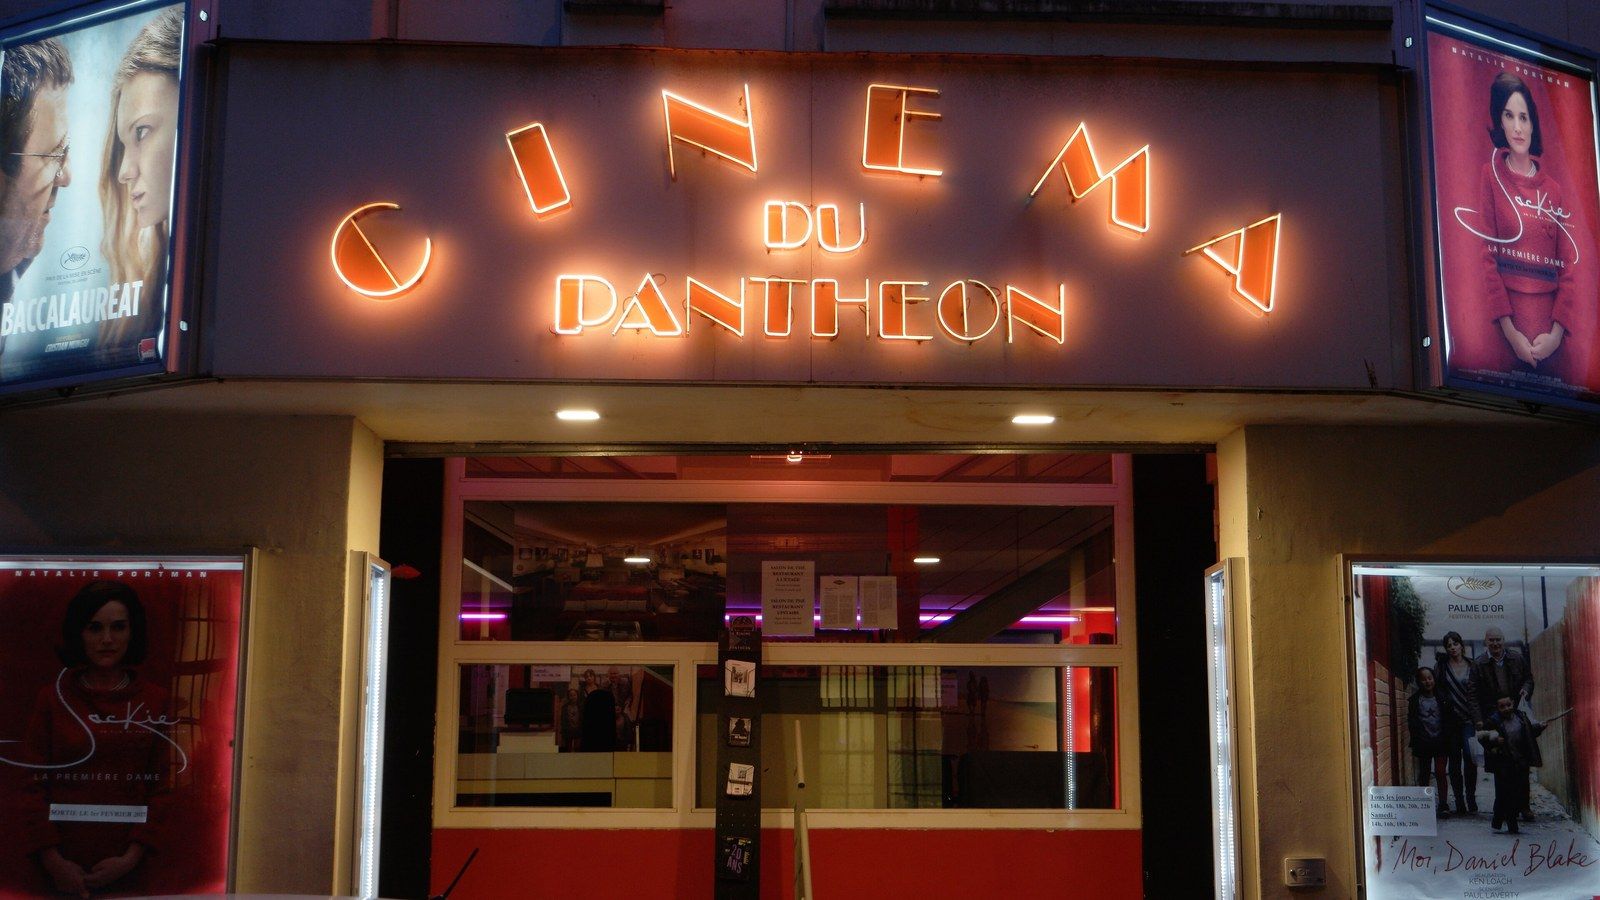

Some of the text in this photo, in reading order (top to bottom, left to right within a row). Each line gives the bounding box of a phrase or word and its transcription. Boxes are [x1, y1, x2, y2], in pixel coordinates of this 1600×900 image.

[1451, 46, 1570, 88] NATALIE PORTMAN
[331, 83, 1282, 312] CINEMA
[1453, 147, 1579, 265] Jackie
[763, 199, 865, 253] DU
[1487, 244, 1498, 253] LA
[1544, 257, 1565, 268] DAME
[0, 280, 144, 337] BACCALAURÉAT
[554, 272, 1065, 345] PANTHEON
[15, 570, 208, 578] NATALIE PORTMAN
[1448, 604, 1504, 613] PALME D'OR
[33, 771, 161, 781] LA PREMIÈRE DAME
[1392, 838, 1600, 877] Moi, Daniel Blake
[1463, 891, 1520, 899] PAUL LAVERTY
